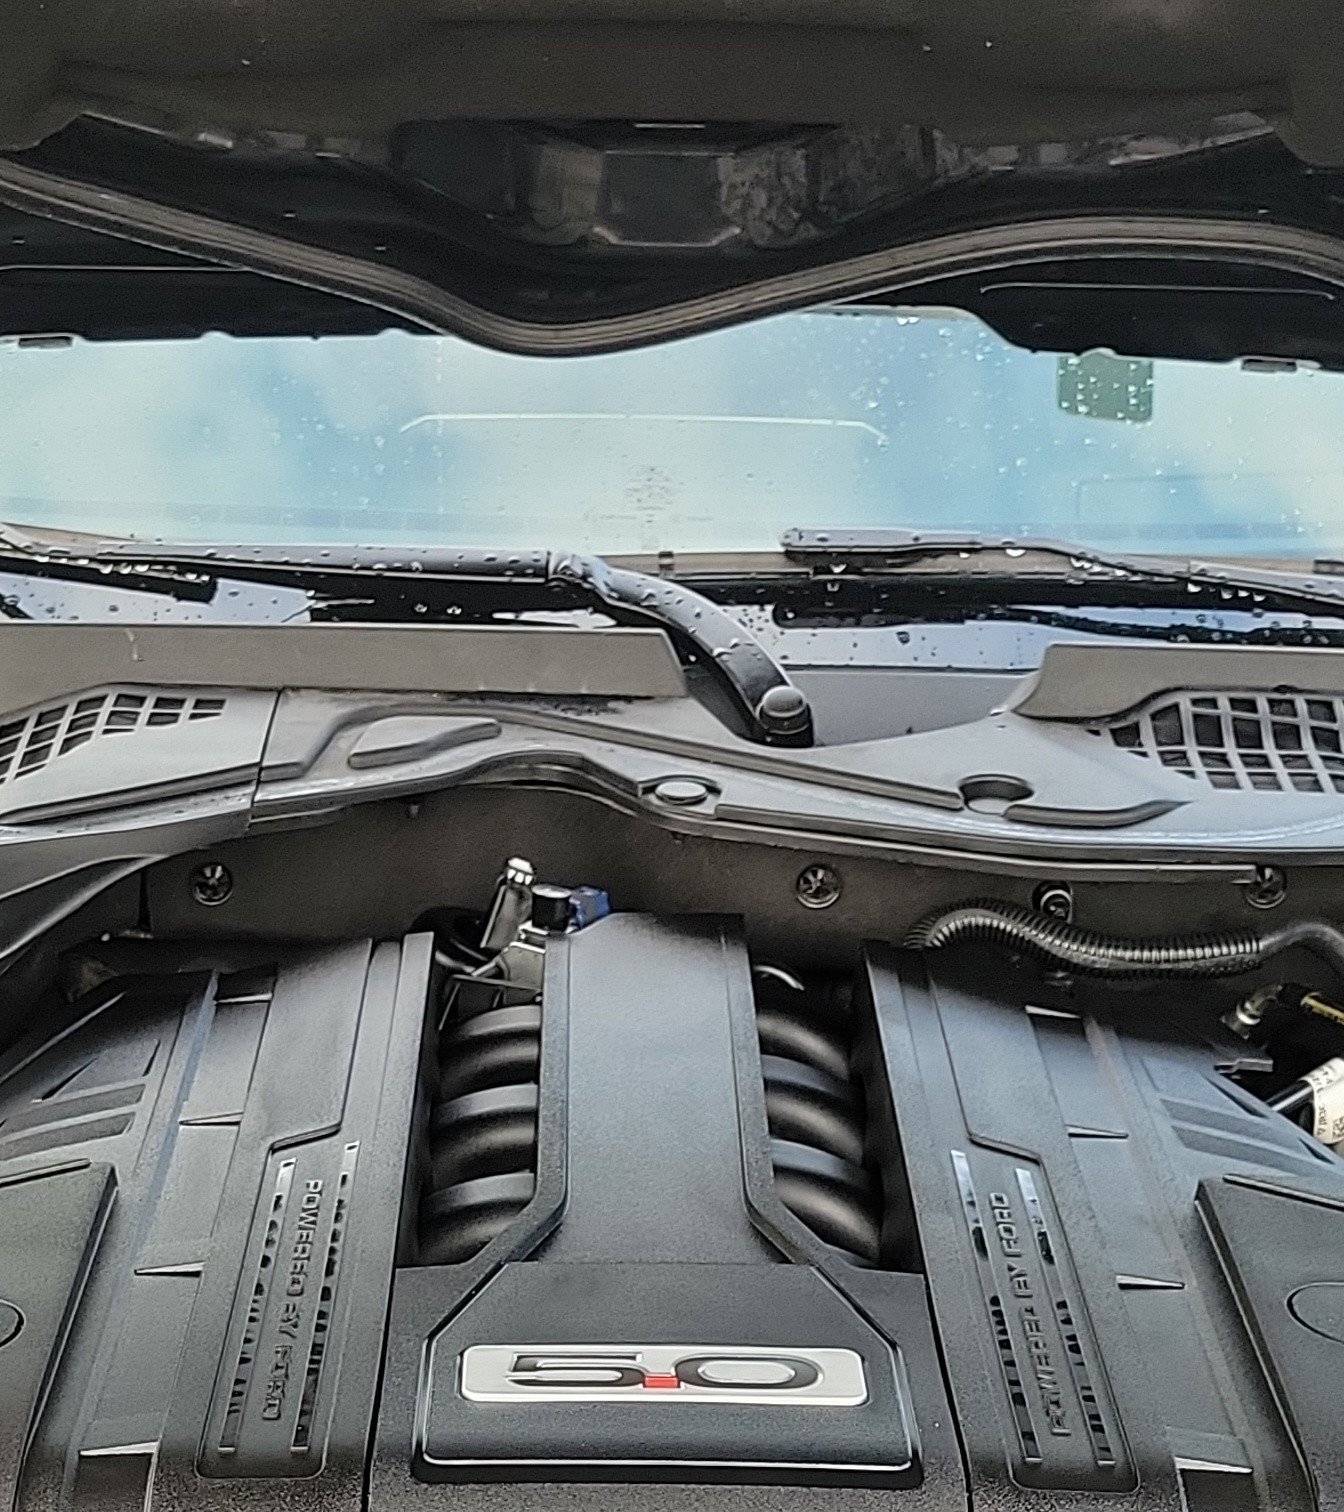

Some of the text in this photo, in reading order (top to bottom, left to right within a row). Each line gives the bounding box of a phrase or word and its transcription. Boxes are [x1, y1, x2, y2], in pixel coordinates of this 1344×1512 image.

[285, 1179, 324, 1297] POWERED
[278, 1303, 301, 1338] BY
[989, 1192, 1072, 1437] POWERED BY FORD
[505, 1351, 824, 1391] 5.0
